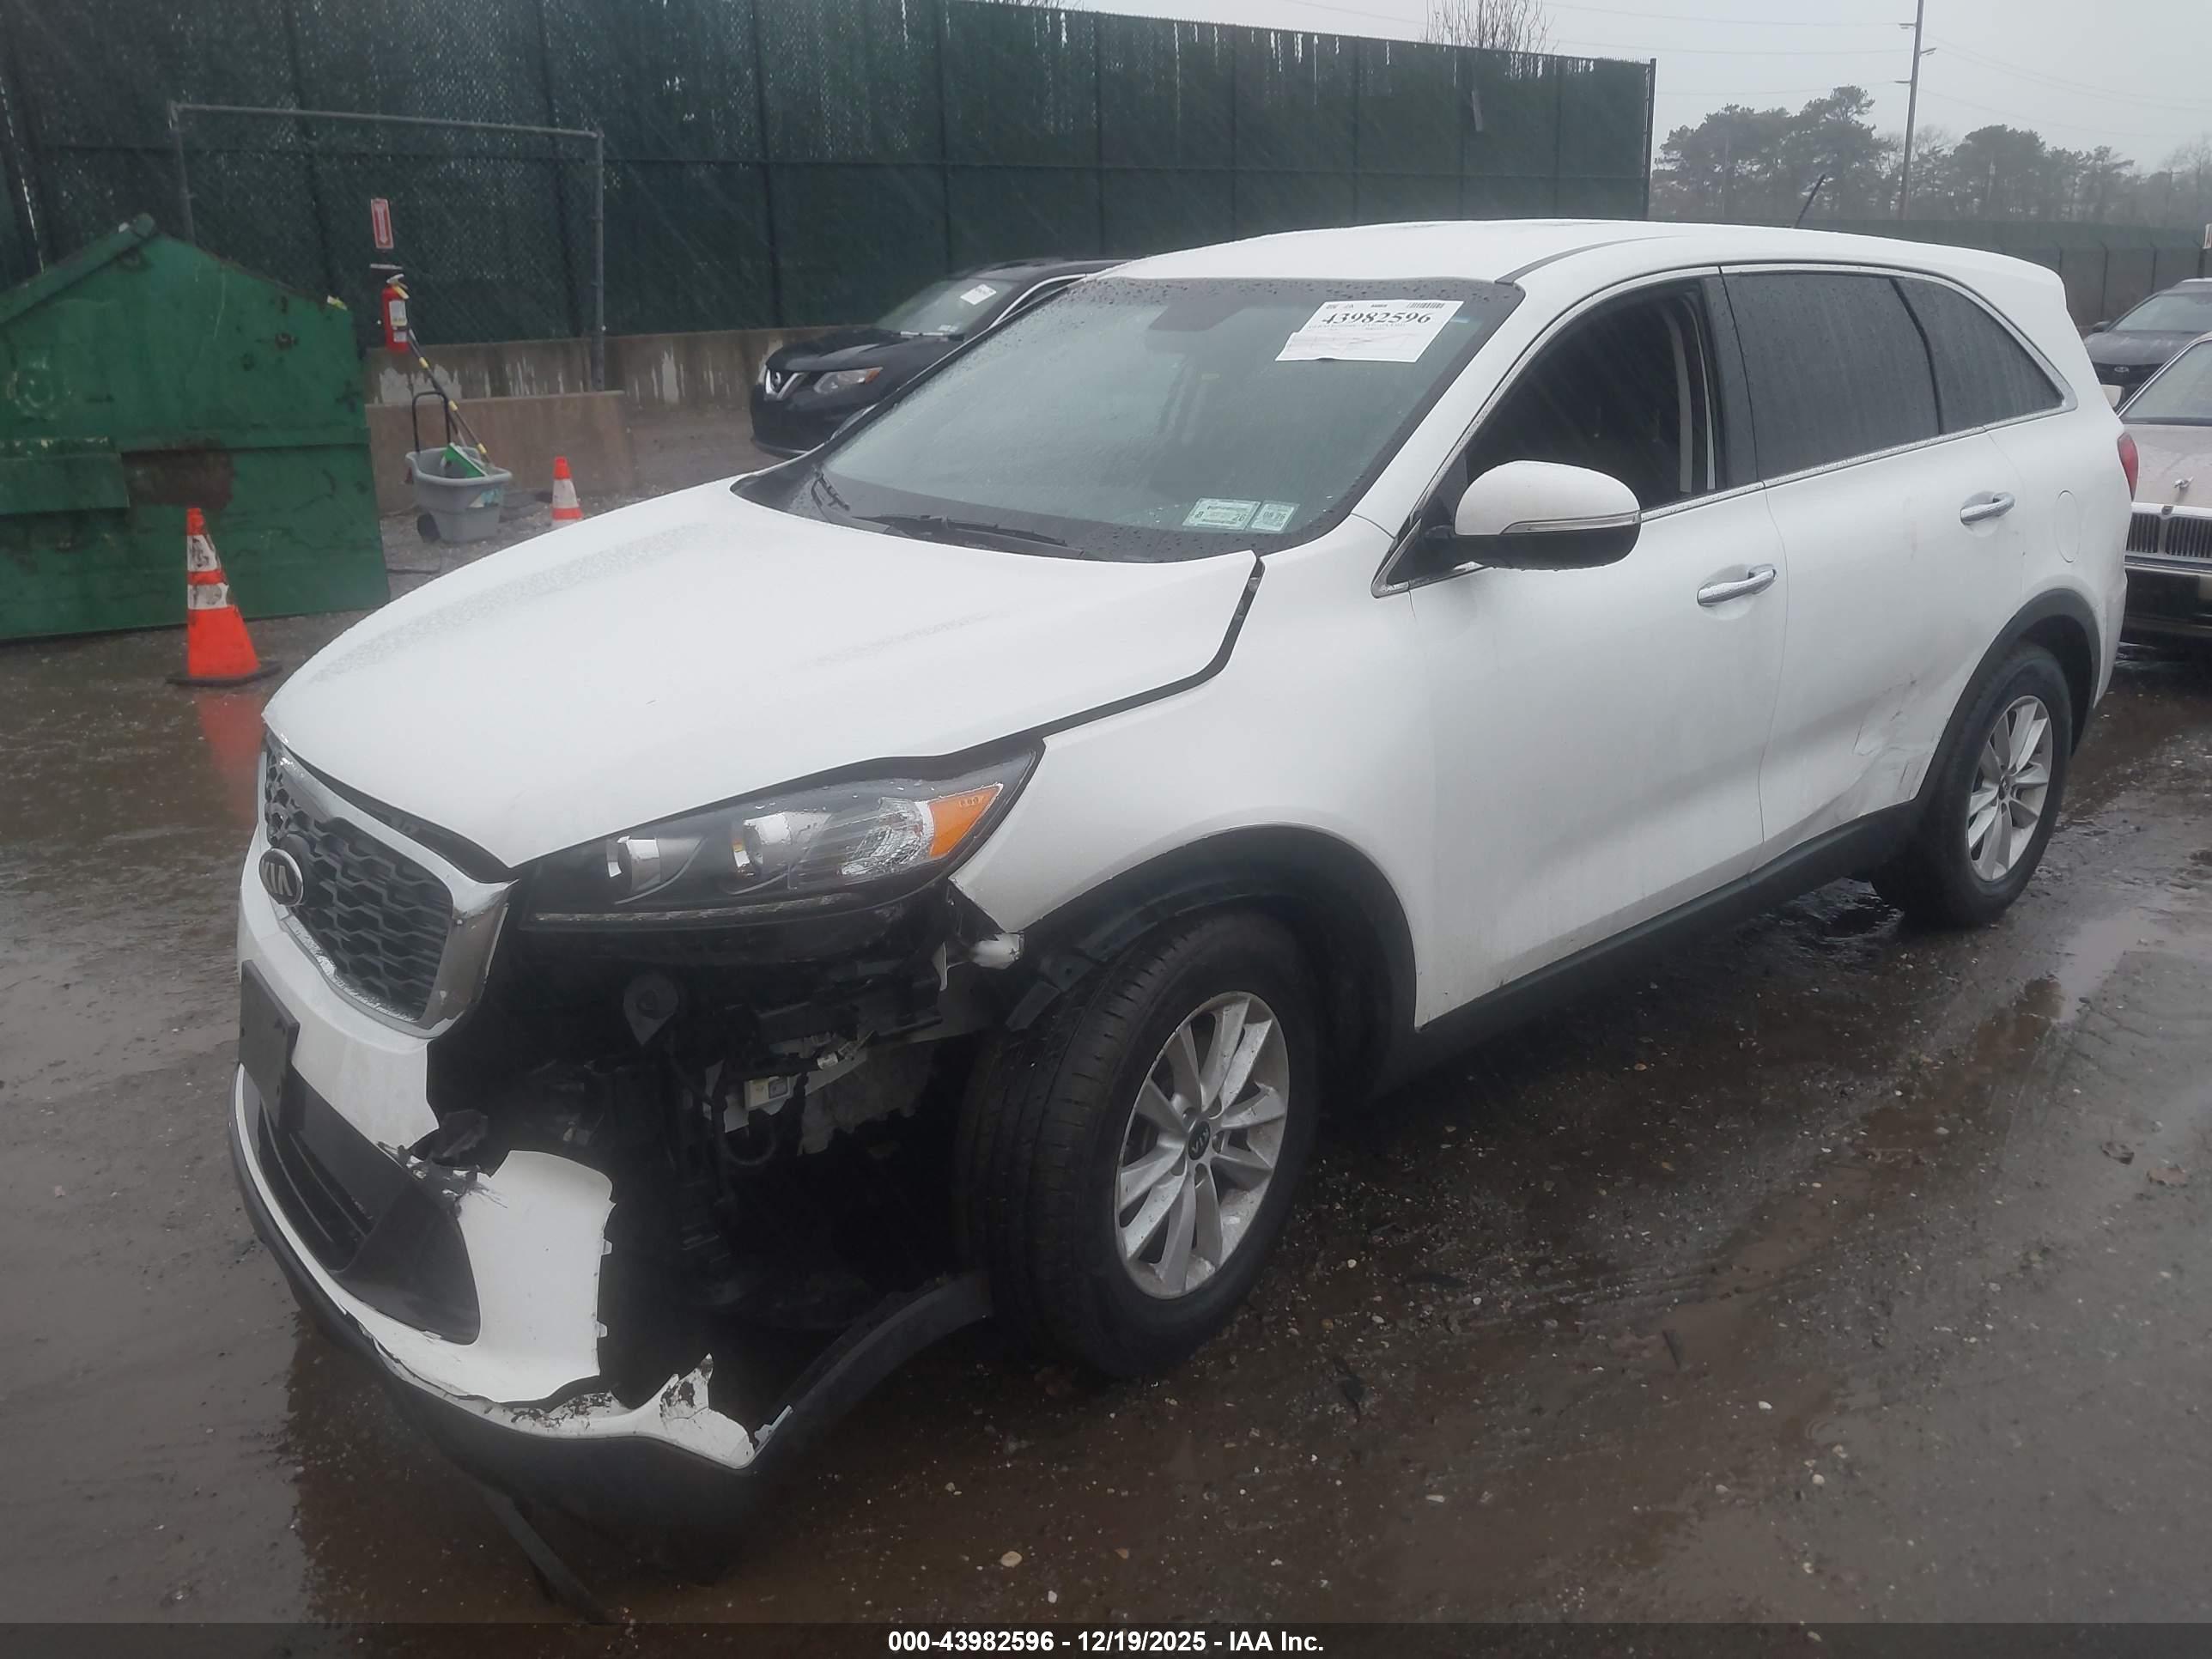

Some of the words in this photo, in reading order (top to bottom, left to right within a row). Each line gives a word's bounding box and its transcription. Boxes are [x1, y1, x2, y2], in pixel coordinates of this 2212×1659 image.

[1322, 312, 1431, 324] 43982596
[260, 855, 293, 896] KIA
[1191, 1128, 1210, 1153] KIA
